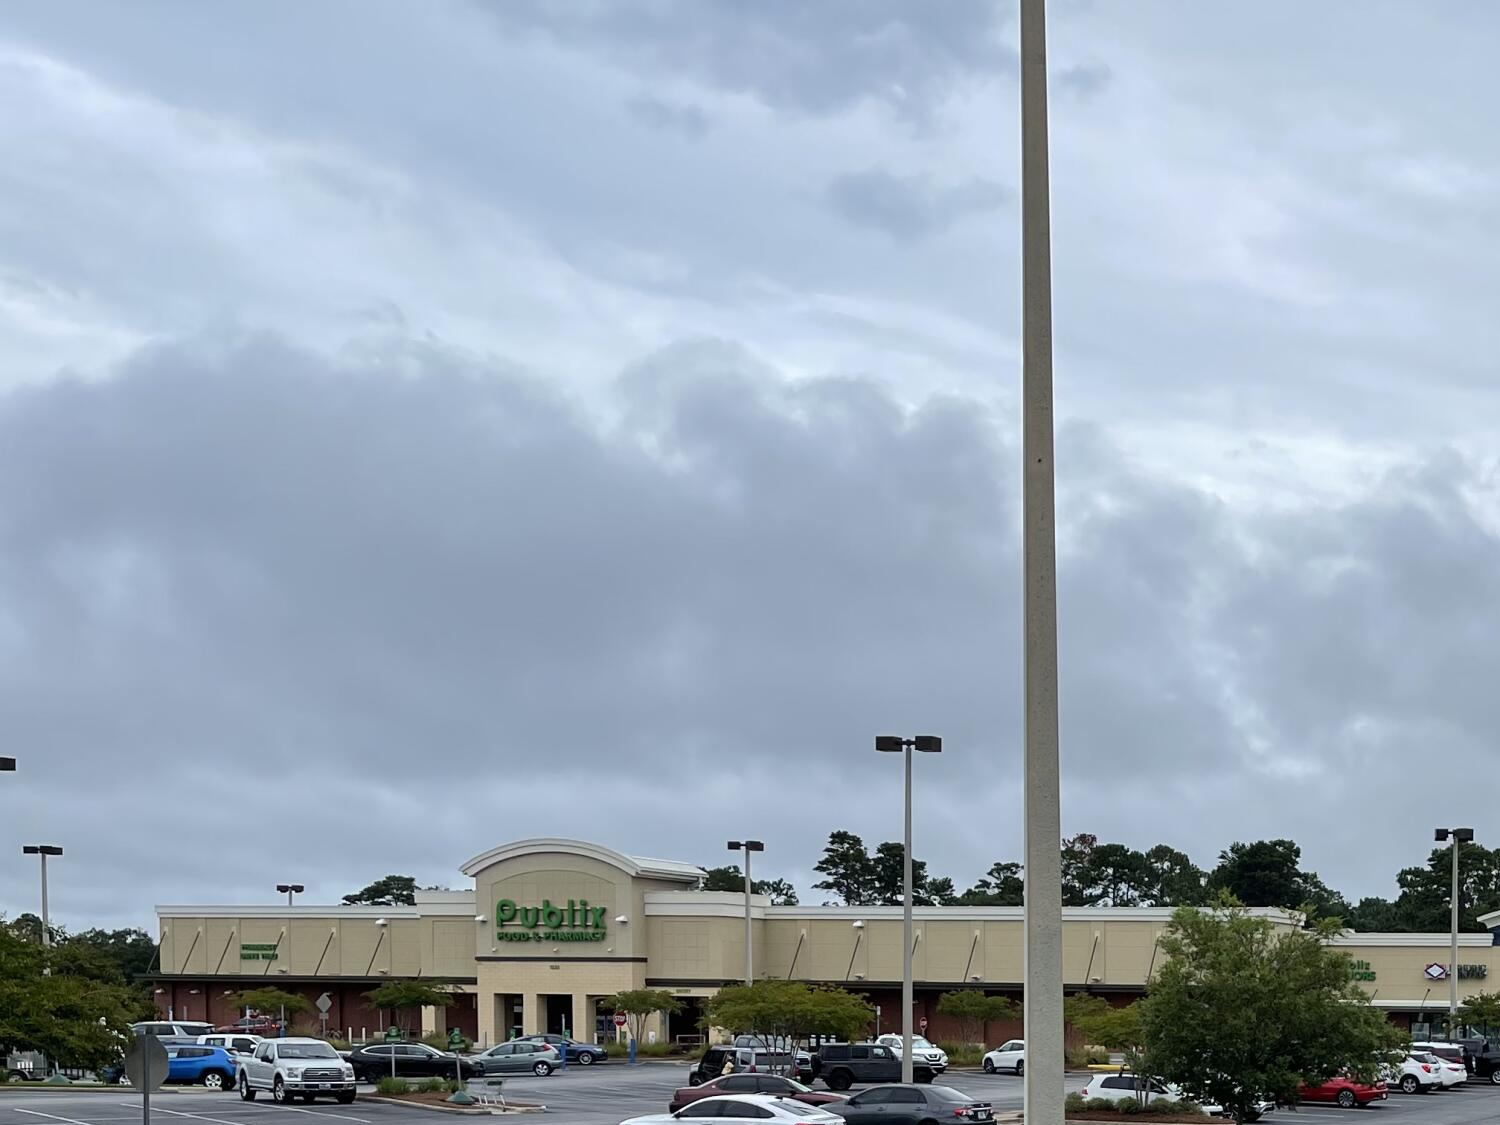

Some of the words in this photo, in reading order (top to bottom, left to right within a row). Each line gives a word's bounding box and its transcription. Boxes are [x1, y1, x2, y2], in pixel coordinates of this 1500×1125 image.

[496, 899, 607, 929] Publix
[497, 932, 529, 941] FOOD
[544, 932, 606, 942] PHARMACY
